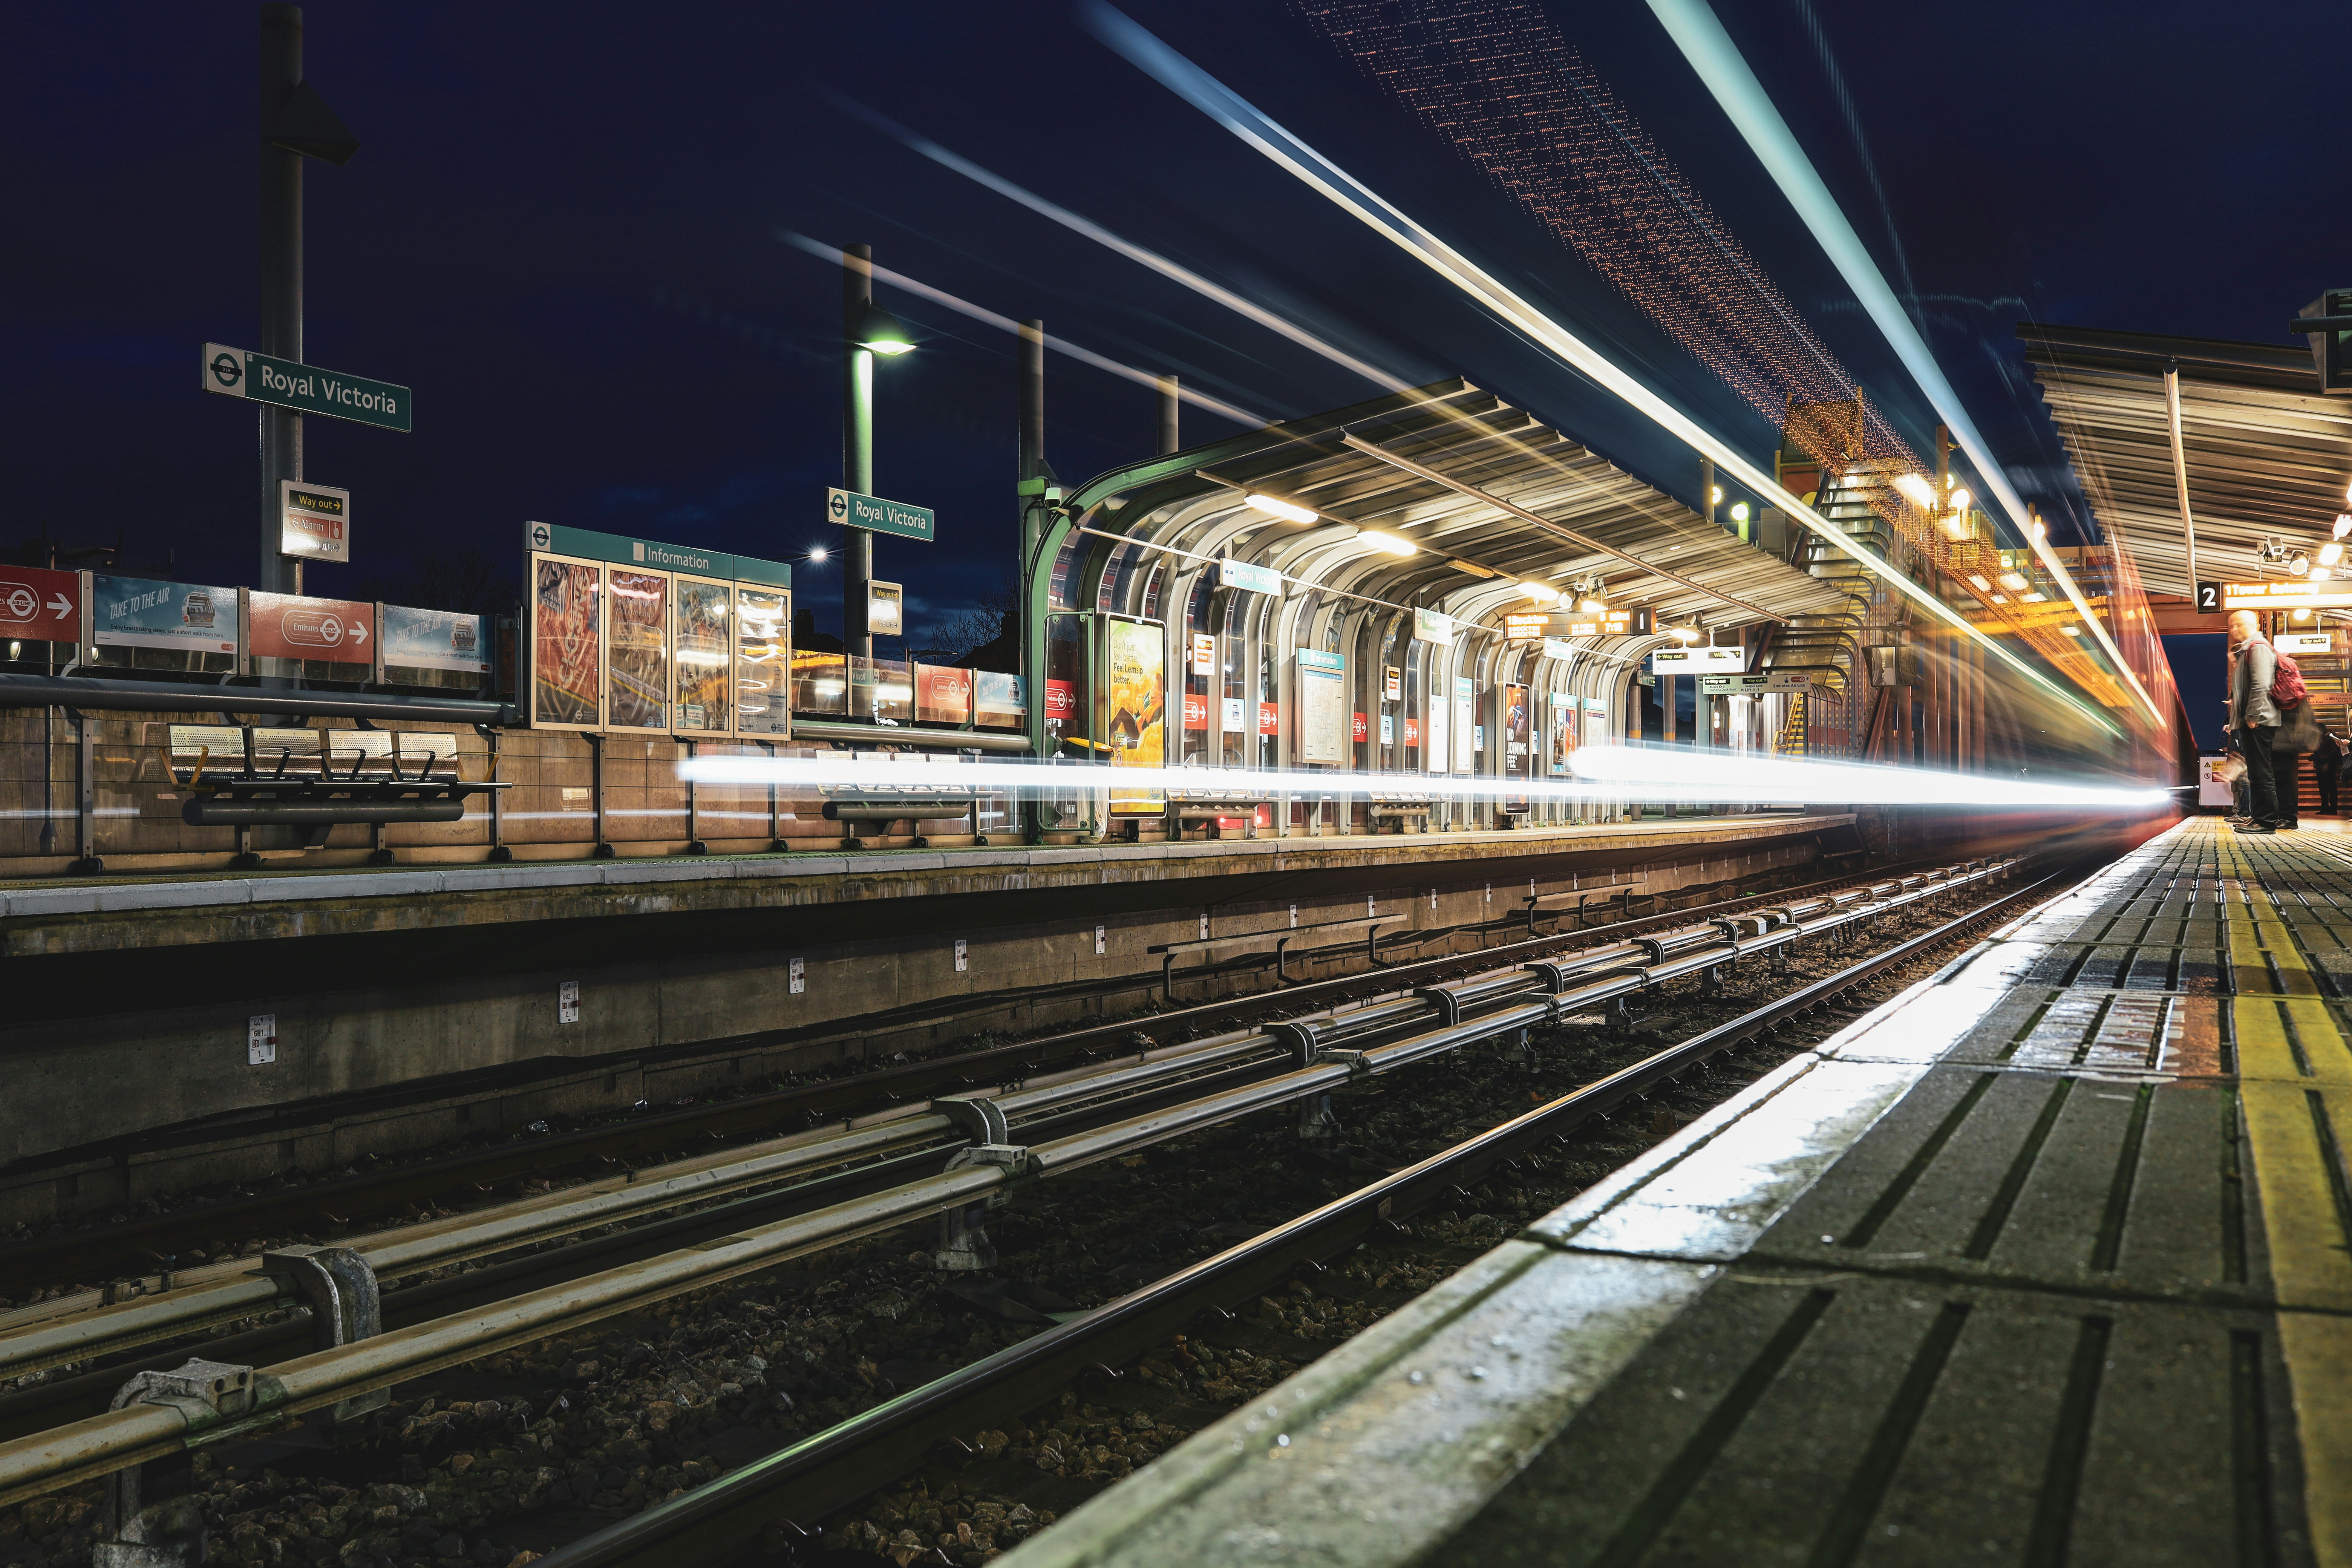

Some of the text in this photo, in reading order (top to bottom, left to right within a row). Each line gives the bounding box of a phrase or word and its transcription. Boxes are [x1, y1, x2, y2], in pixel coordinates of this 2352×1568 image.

[262, 365, 396, 414] Royal Victoria
[299, 495, 332, 509] Way out
[856, 500, 926, 530] Royal Victoria
[300, 519, 323, 532] Alarm
[648, 547, 709, 570] Information
[1238, 567, 1274, 586] Royal Victor
[876, 589, 885, 598] Way
[2232, 584, 2267, 595] Tower
[2202, 587, 2216, 606] 2
[110, 587, 169, 620] TAKE TO THE AIR
[543, 599, 560, 610] CLEAR
[1640, 612, 1644, 629] 1
[294, 623, 319, 632] Emirates
[397, 627, 410, 645] TAKE
[412, 624, 419, 639] TO
[420, 620, 430, 635] THE
[1113, 639, 1136, 652] Don't just
[1113, 651, 1138, 663] feel better.
[1315, 653, 1337, 665] Information
[1114, 662, 1143, 677] Feel Lemsip
[615, 672, 631, 684] MIND
[1114, 674, 1130, 684] better.
[1507, 728, 1514, 741] NO
[1507, 742, 1527, 755] JOINING
